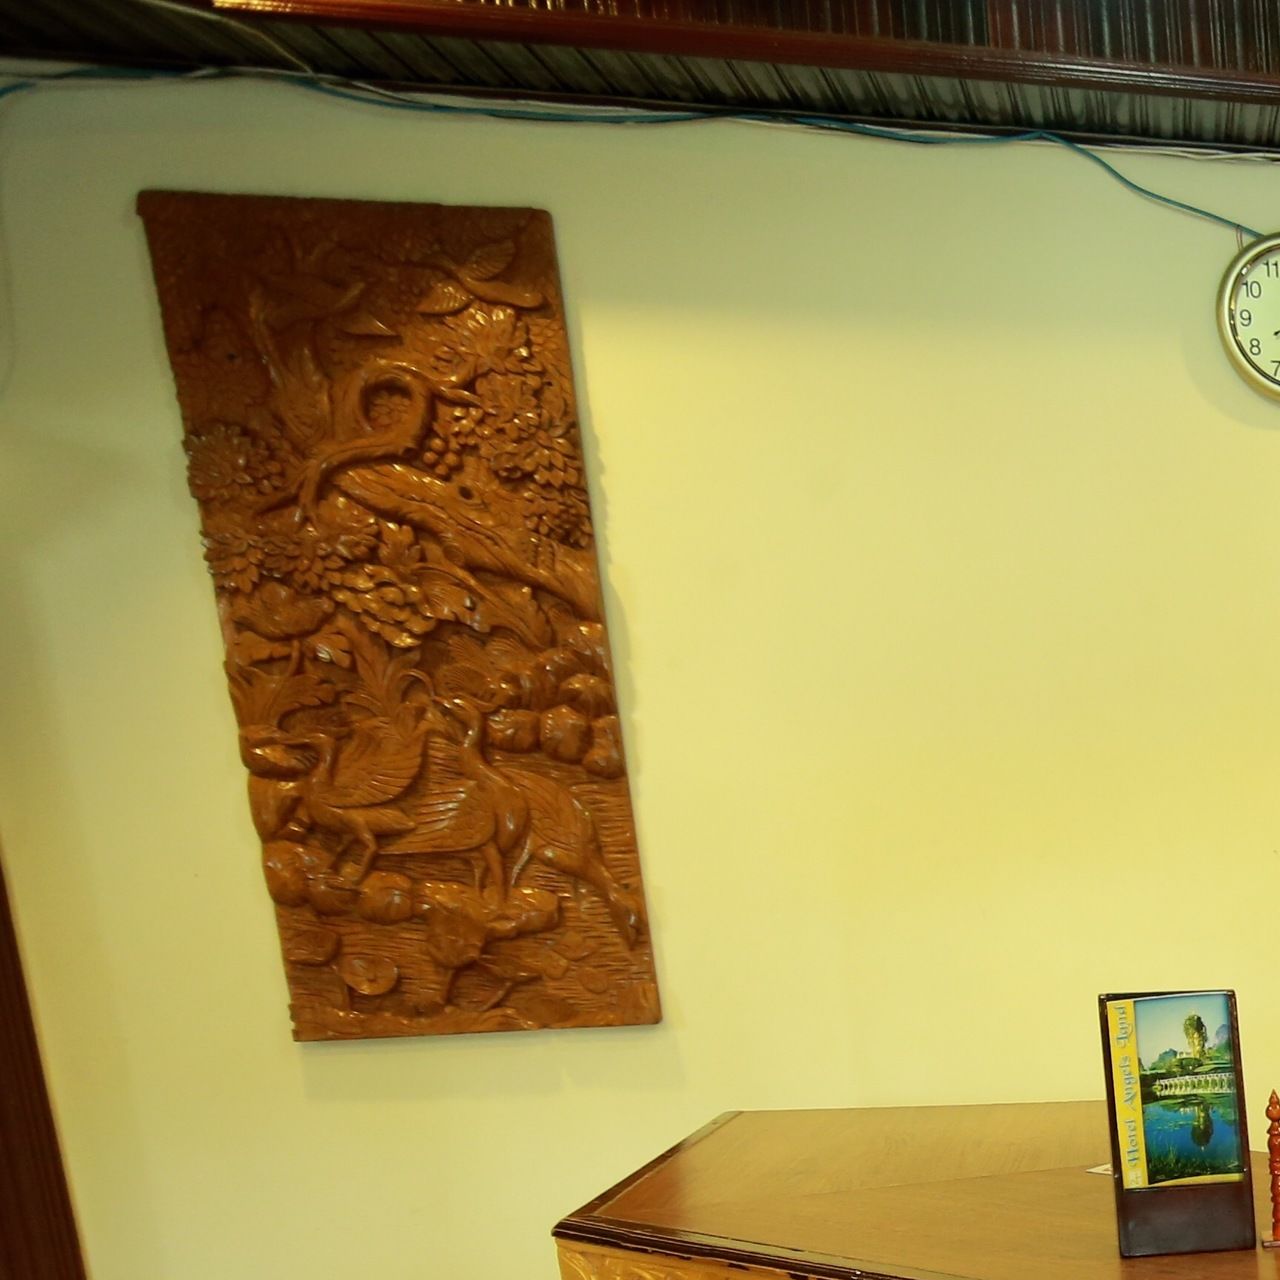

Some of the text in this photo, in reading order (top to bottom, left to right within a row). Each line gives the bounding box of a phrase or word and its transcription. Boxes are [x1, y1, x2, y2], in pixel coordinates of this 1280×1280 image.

[1263, 260, 1279, 278] 11
[1241, 280, 1262, 299] 10
[1239, 309, 1252, 327] 9
[1249, 338, 1262, 356] 8
[1113, 1005, 1134, 1049] Land
[1118, 1055, 1139, 1112] Angels
[1125, 1119, 1140, 1168] Hotel
